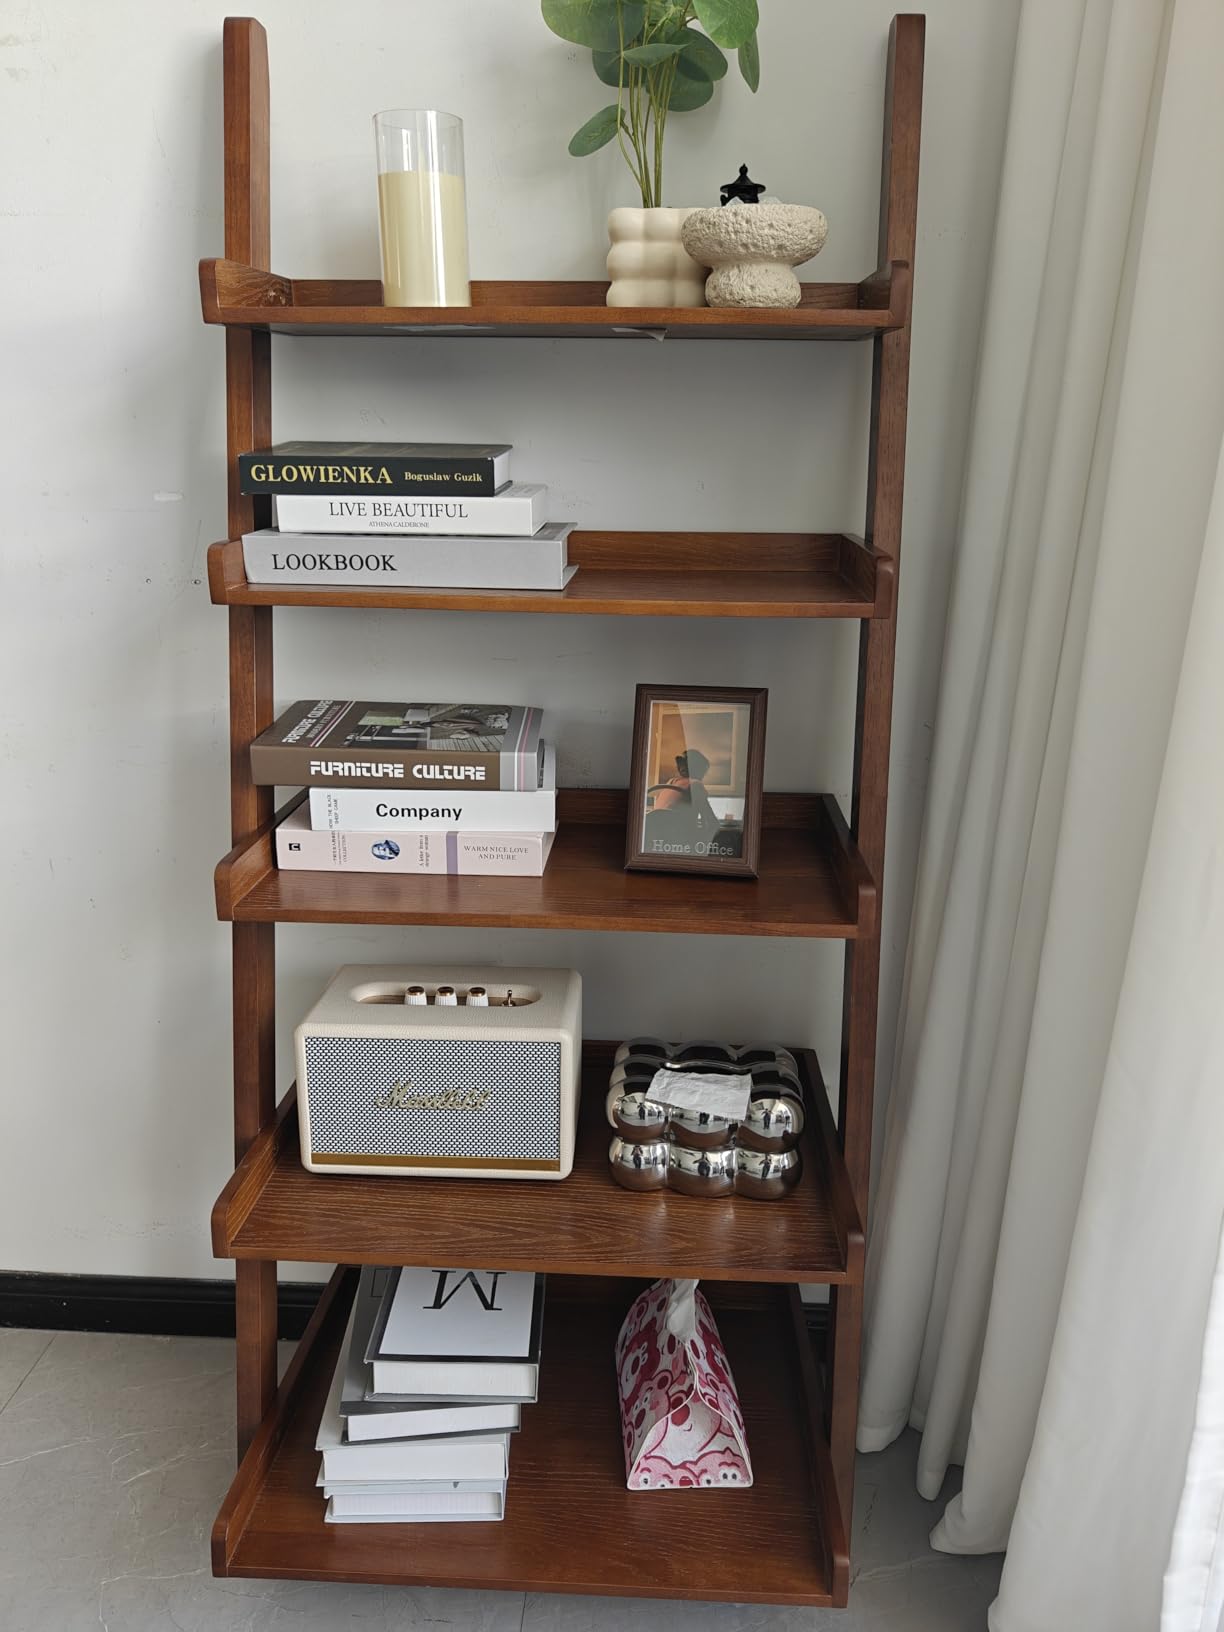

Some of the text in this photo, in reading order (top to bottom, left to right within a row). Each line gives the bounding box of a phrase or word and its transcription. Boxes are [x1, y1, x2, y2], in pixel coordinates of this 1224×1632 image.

[250, 464, 483, 485] GLOWIENKA Boguslaw Guzik
[329, 502, 468, 519] LIVE BEAUTIFUL
[271, 553, 398, 572] LOOKBOOK
[412, 764, 486, 781] CULTURE
[375, 803, 463, 821] Company
[652, 839, 734, 856] Home Office
